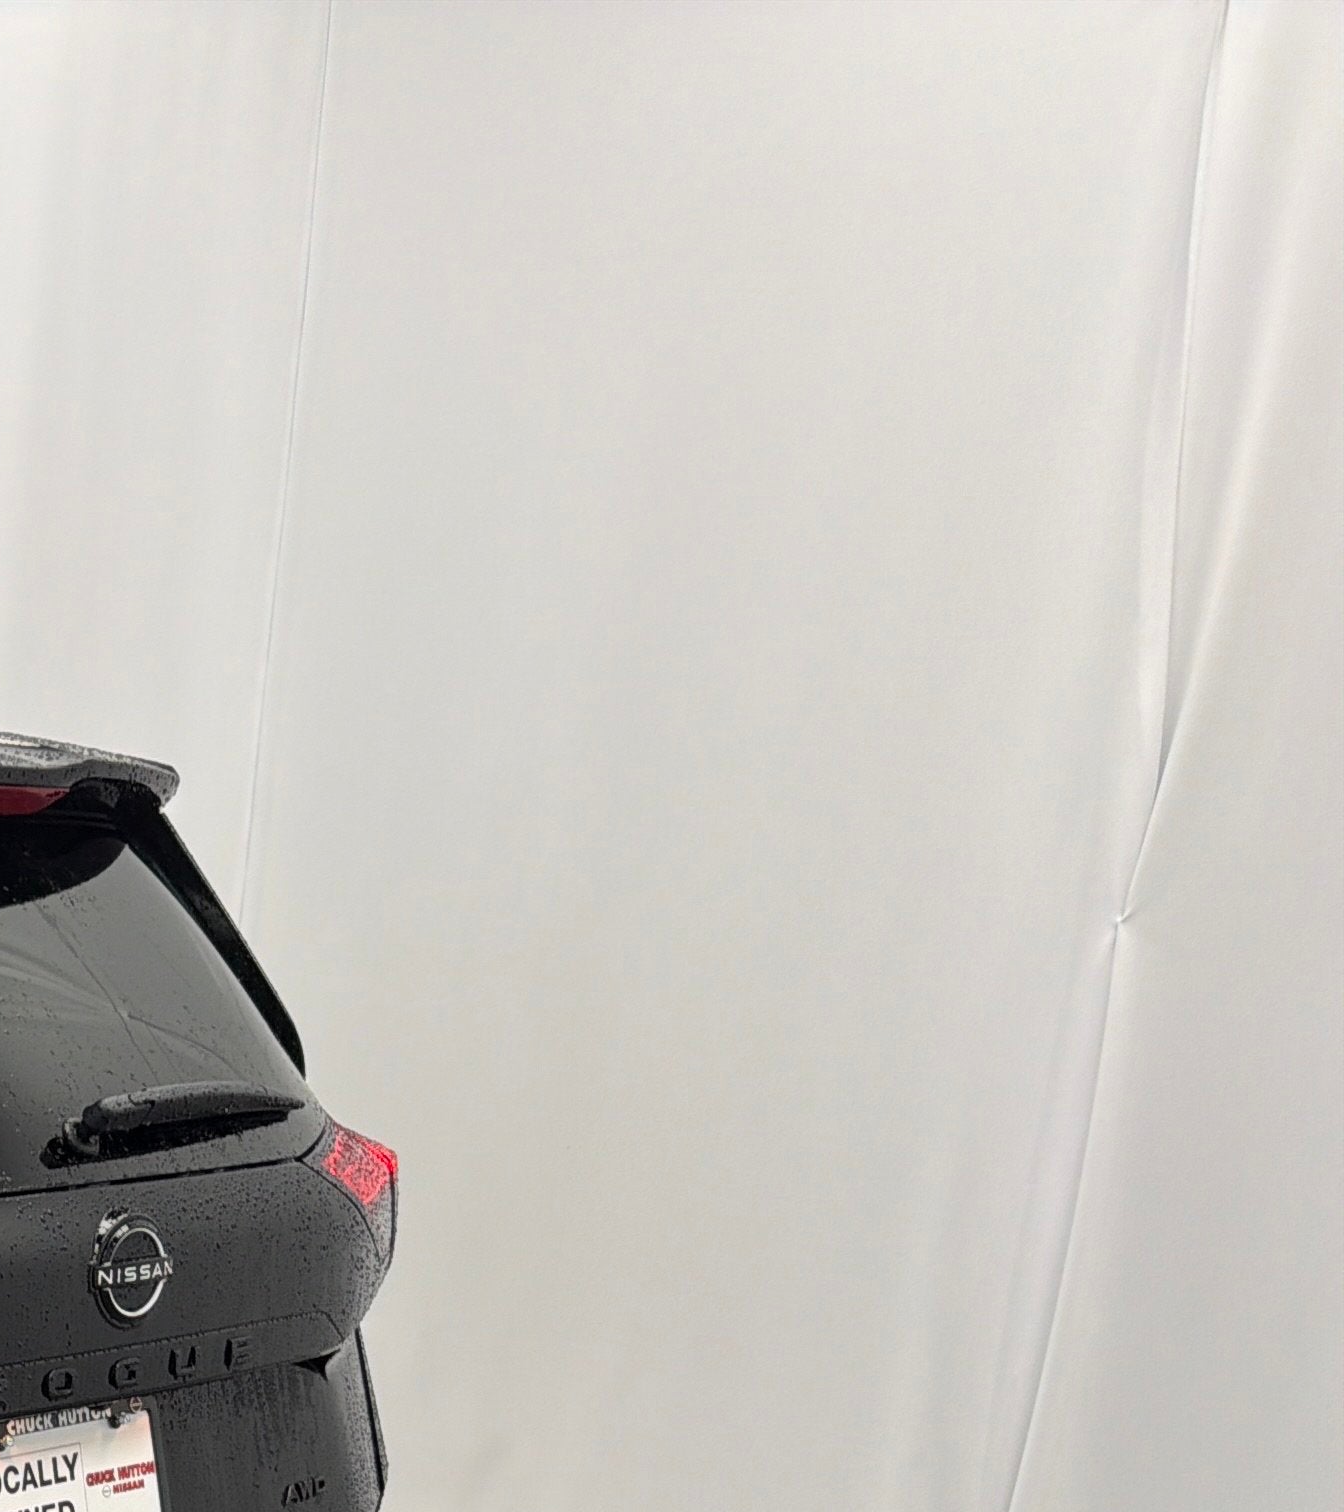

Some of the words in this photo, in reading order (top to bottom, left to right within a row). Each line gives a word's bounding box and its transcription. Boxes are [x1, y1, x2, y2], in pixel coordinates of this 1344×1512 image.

[97, 1261, 174, 1286] NISSAN
[6, 1413, 53, 1436] CHUCK
[57, 1405, 112, 1426] HUTTON
[85, 1469, 116, 1487] CHUCK
[117, 1461, 155, 1481] HUTTON
[112, 1479, 145, 1495] NISSAN
